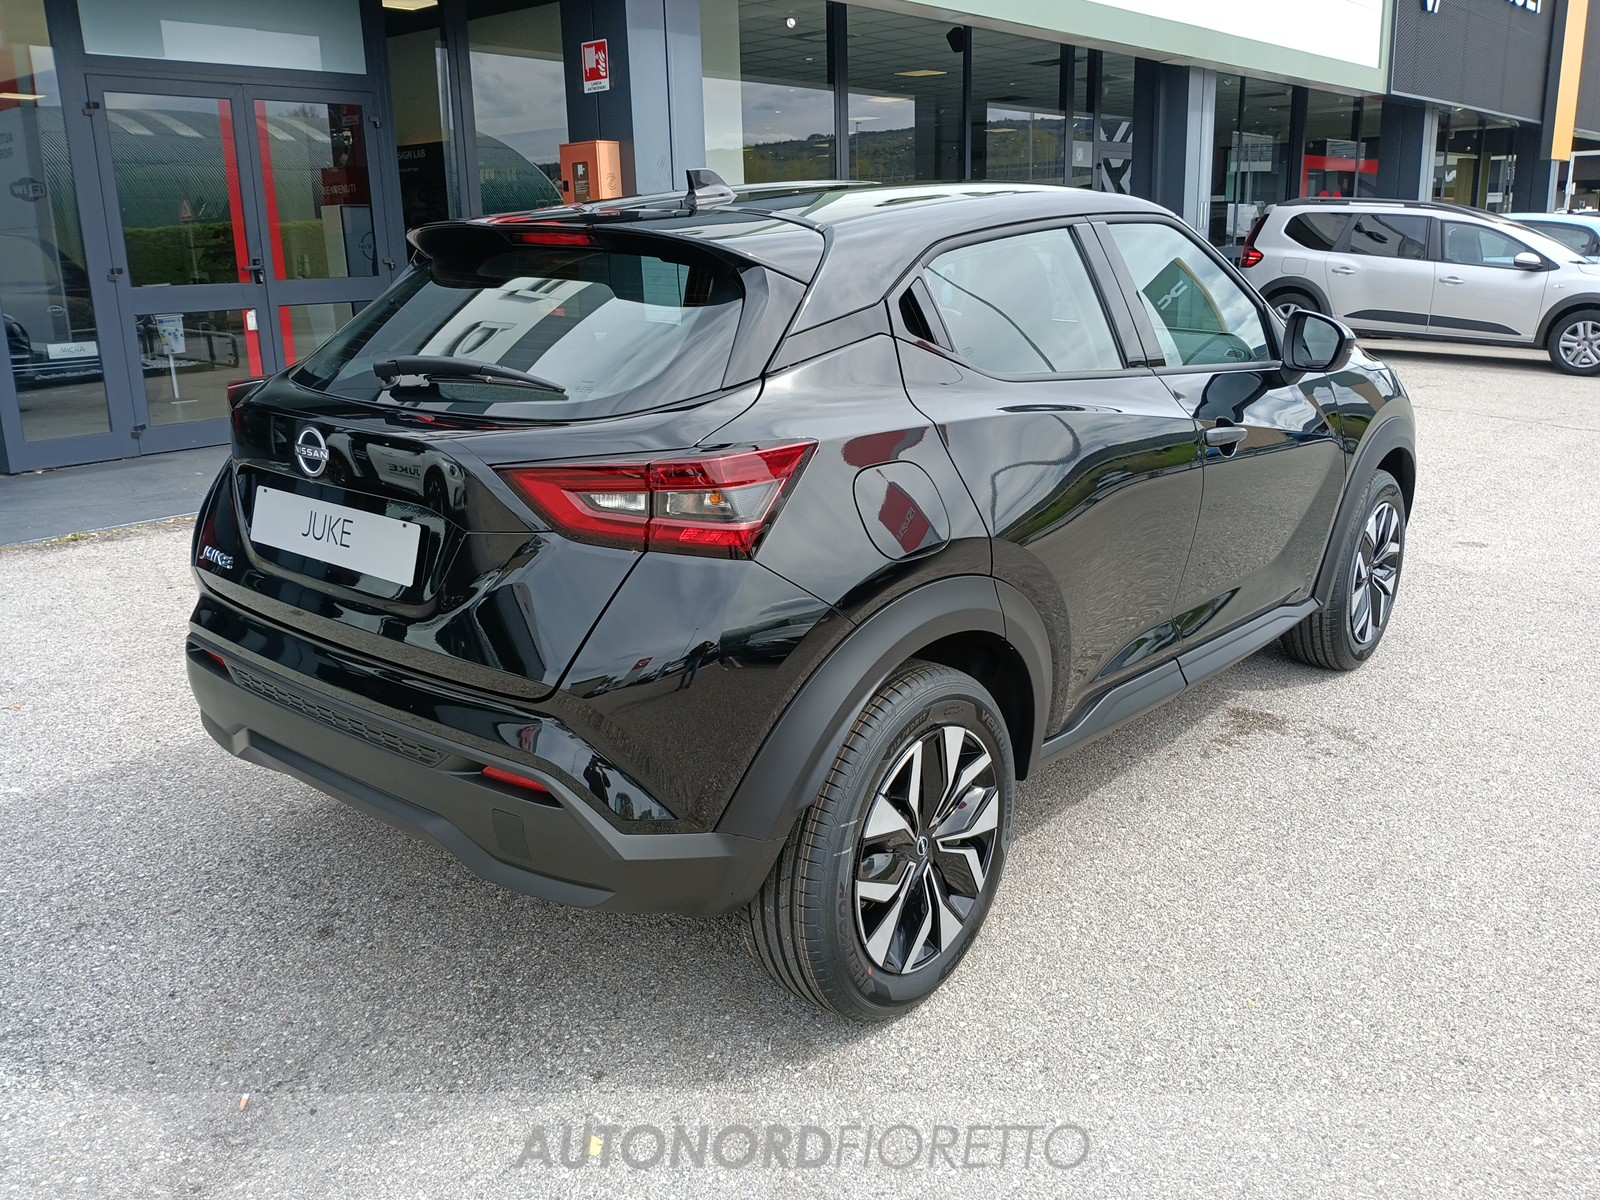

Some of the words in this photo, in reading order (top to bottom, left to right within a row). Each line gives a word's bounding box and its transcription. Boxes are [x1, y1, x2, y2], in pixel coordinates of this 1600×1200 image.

[397, 150, 412, 160] SIGN
[413, 149, 426, 158] LAB
[322, 184, 357, 195] BENVENUTI
[60, 346, 86, 354] MICRA
[295, 445, 328, 459] NISSAN
[301, 510, 354, 548] JUKE
[199, 545, 234, 570] JUKE
